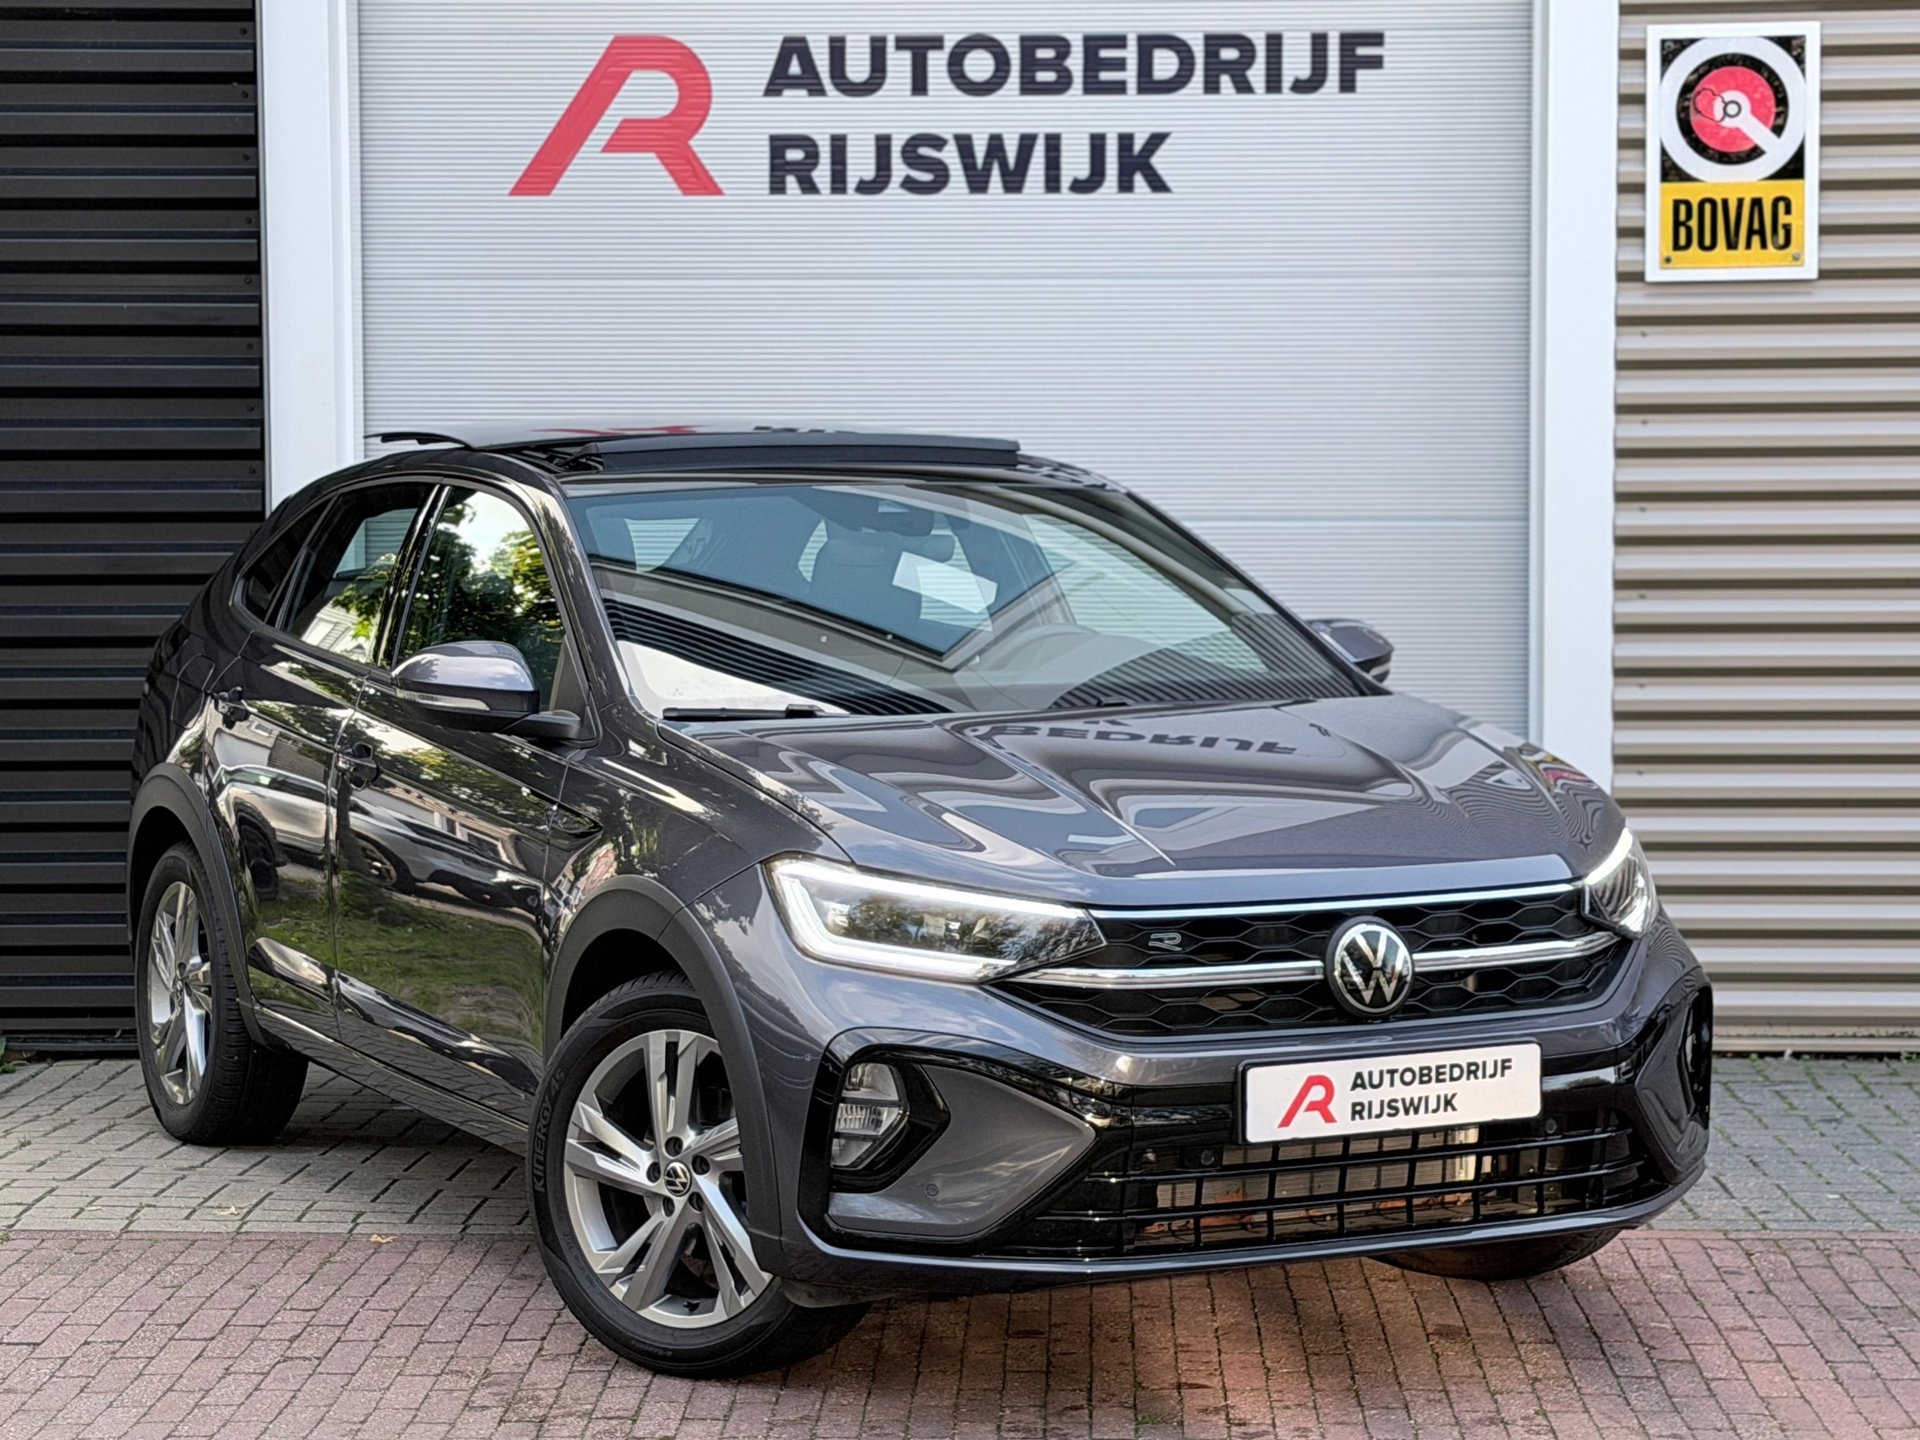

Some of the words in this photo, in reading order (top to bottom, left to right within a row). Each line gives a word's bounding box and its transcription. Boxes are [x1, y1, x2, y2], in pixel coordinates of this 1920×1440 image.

[762, 31, 1386, 99] AUTOBEDRIJF
[769, 131, 1173, 196] RIJSWIJK
[1672, 196, 1792, 252] BOVAG
[1350, 1058, 1513, 1091] AUTOBEDRIJF
[1350, 1093, 1458, 1121] RIJSWIJK
[533, 1094, 553, 1192] KINERGY
